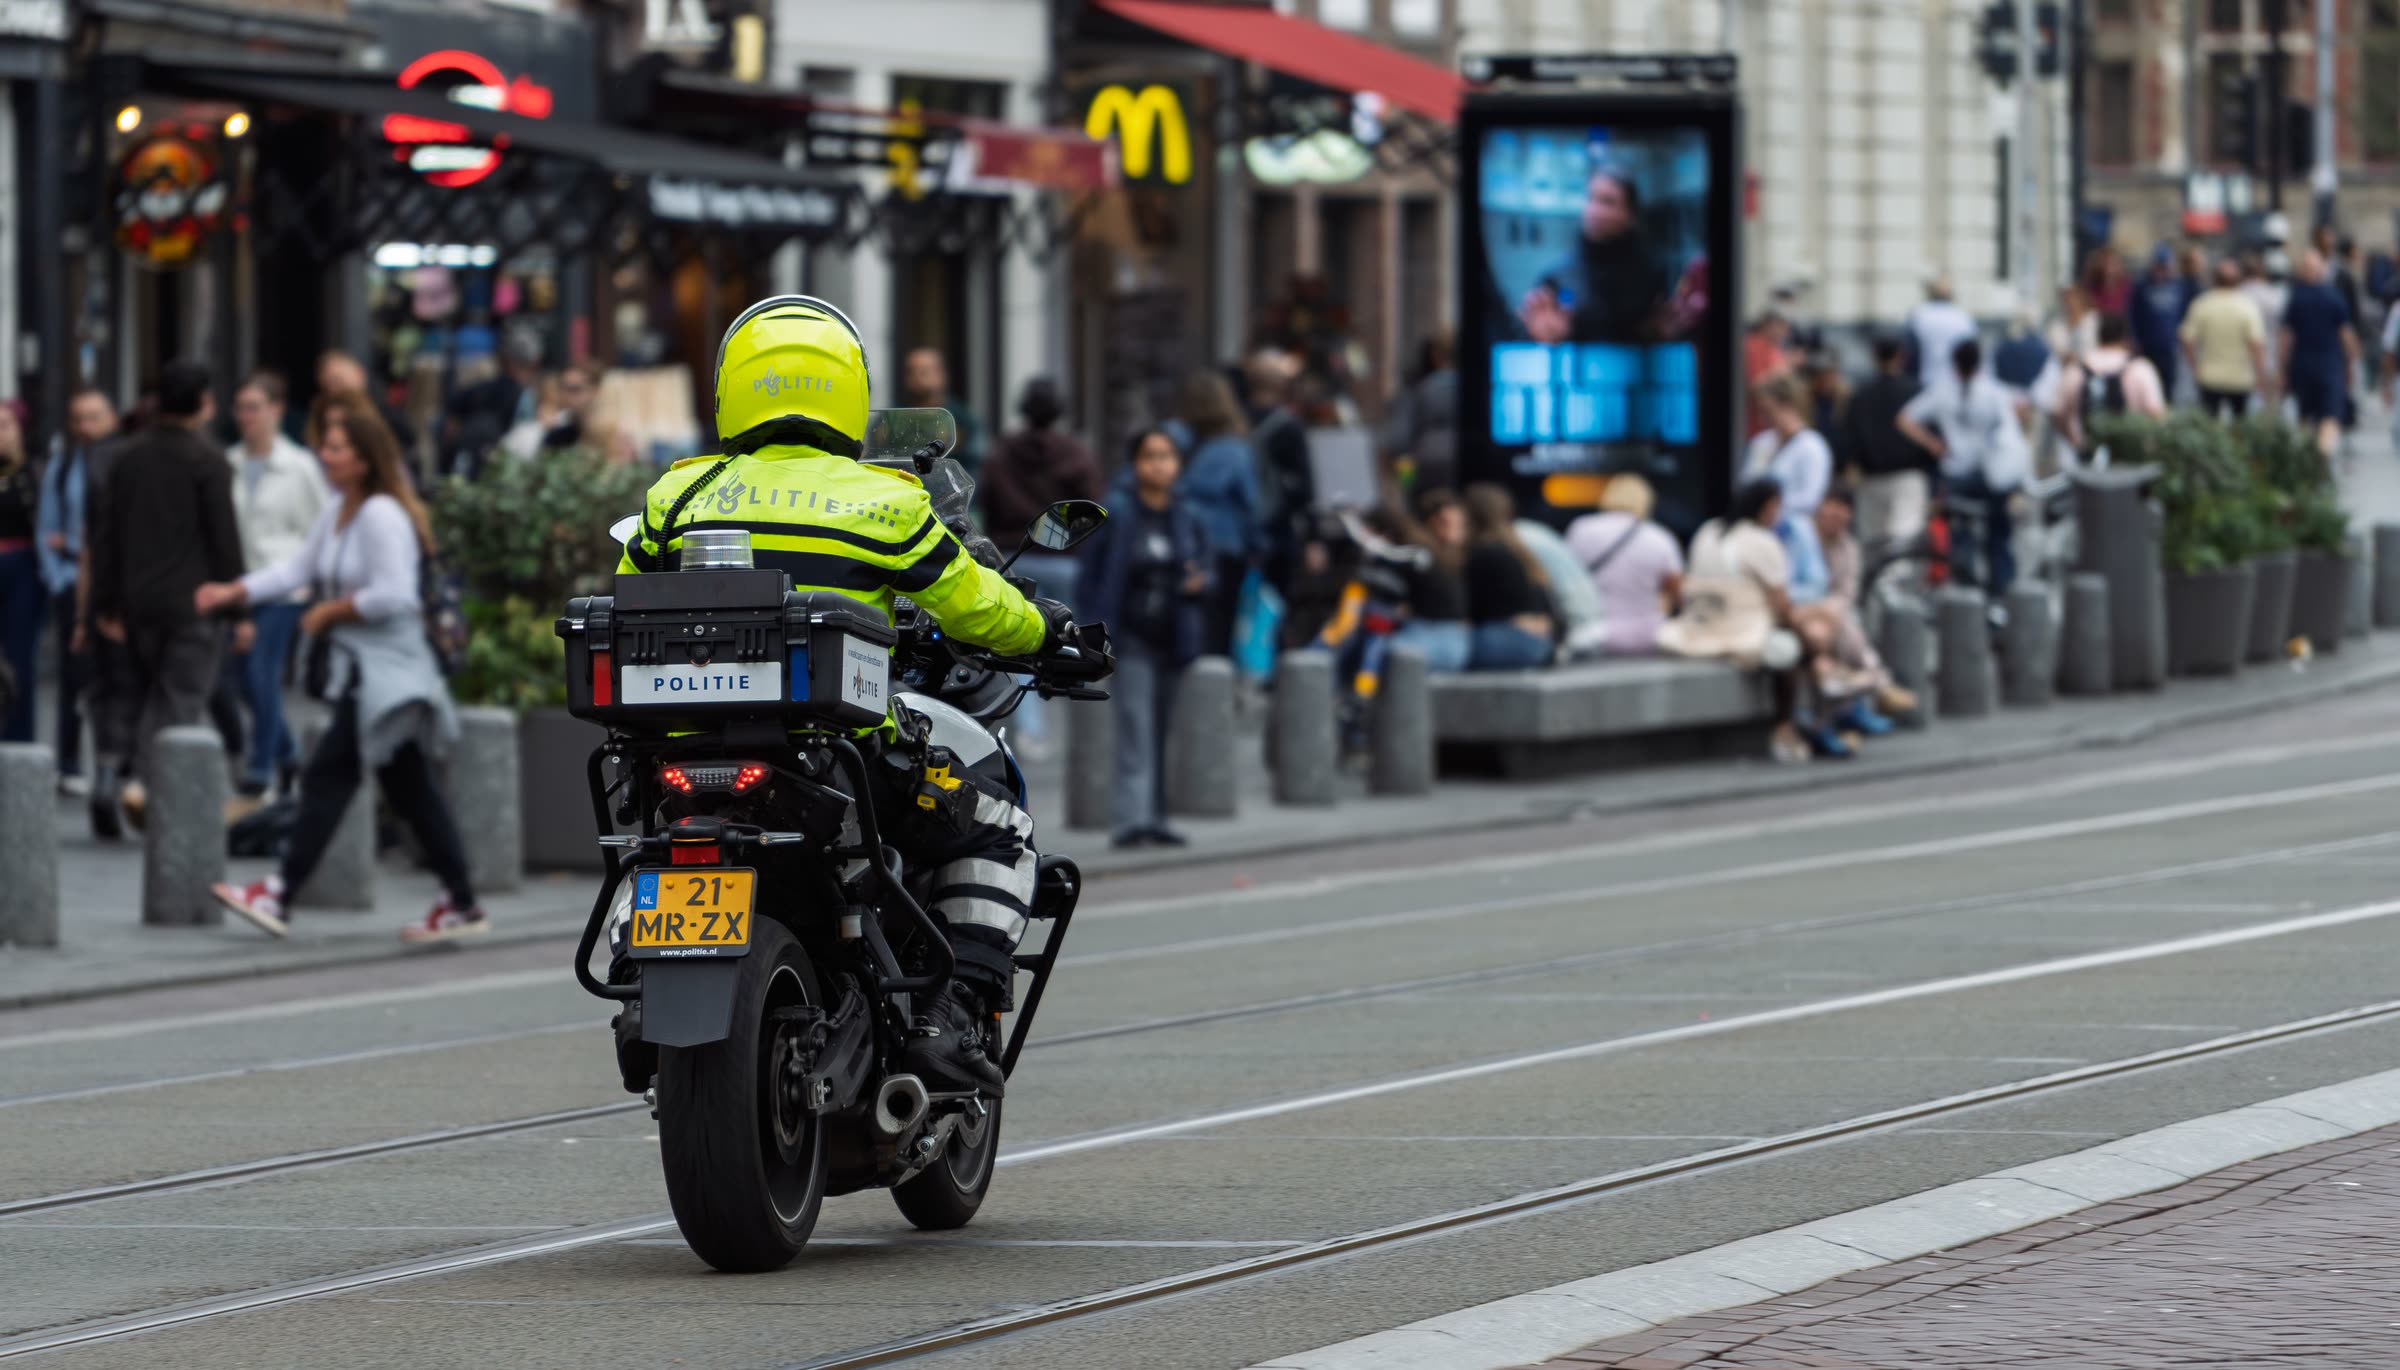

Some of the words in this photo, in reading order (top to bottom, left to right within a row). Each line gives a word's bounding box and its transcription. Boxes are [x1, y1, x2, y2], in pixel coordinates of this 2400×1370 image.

[1085, 85, 1192, 183] M
[752, 372, 833, 396] POLITIE
[703, 479, 840, 515] POLITIE
[654, 675, 750, 692] POLITIE
[853, 671, 878, 699] POLITIE
[640, 896, 654, 904] NL
[686, 877, 721, 906] 21
[637, 912, 744, 942] MR-ZX
[660, 948, 717, 957] www.politie.nl
